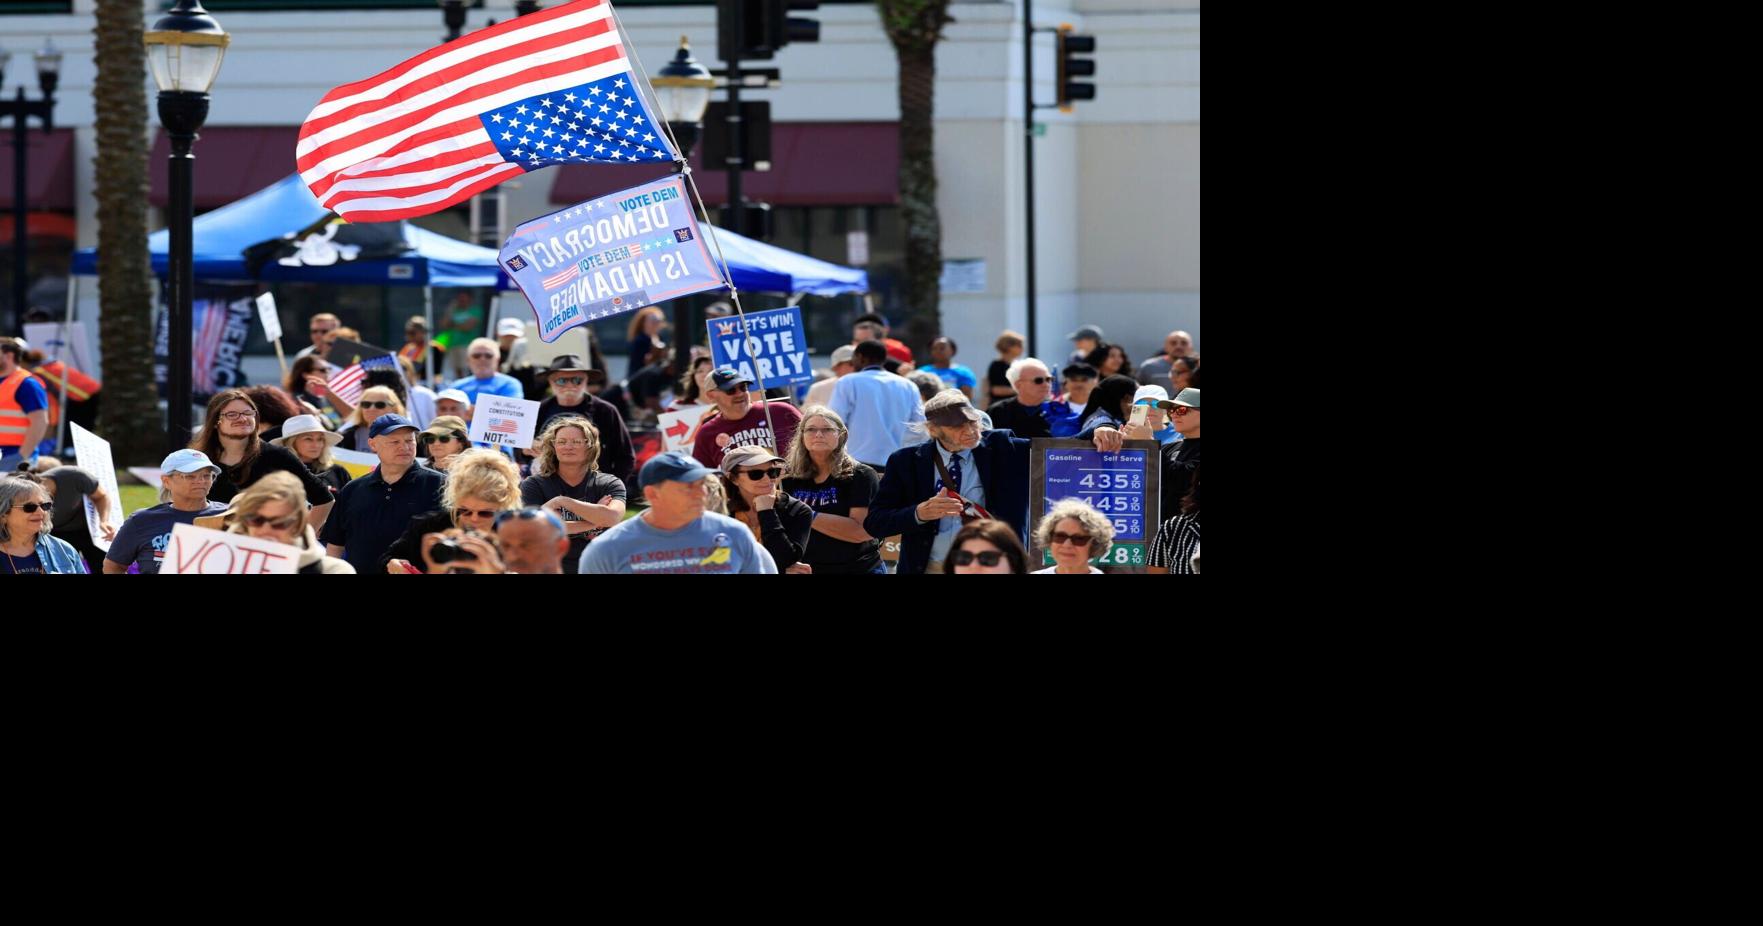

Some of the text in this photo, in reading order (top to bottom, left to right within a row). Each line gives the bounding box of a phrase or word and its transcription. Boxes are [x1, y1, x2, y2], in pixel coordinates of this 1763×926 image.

[620, 186, 679, 212] VOTE DEM
[578, 246, 632, 273] VOTE DEM
[544, 305, 578, 333] VOTE DEM
[736, 312, 795, 333] LET'S WIN!
[722, 330, 795, 361] VOTE
[483, 432, 504, 443] NOT
[1079, 473, 1129, 489] 435
[175, 534, 288, 574] VOTE
